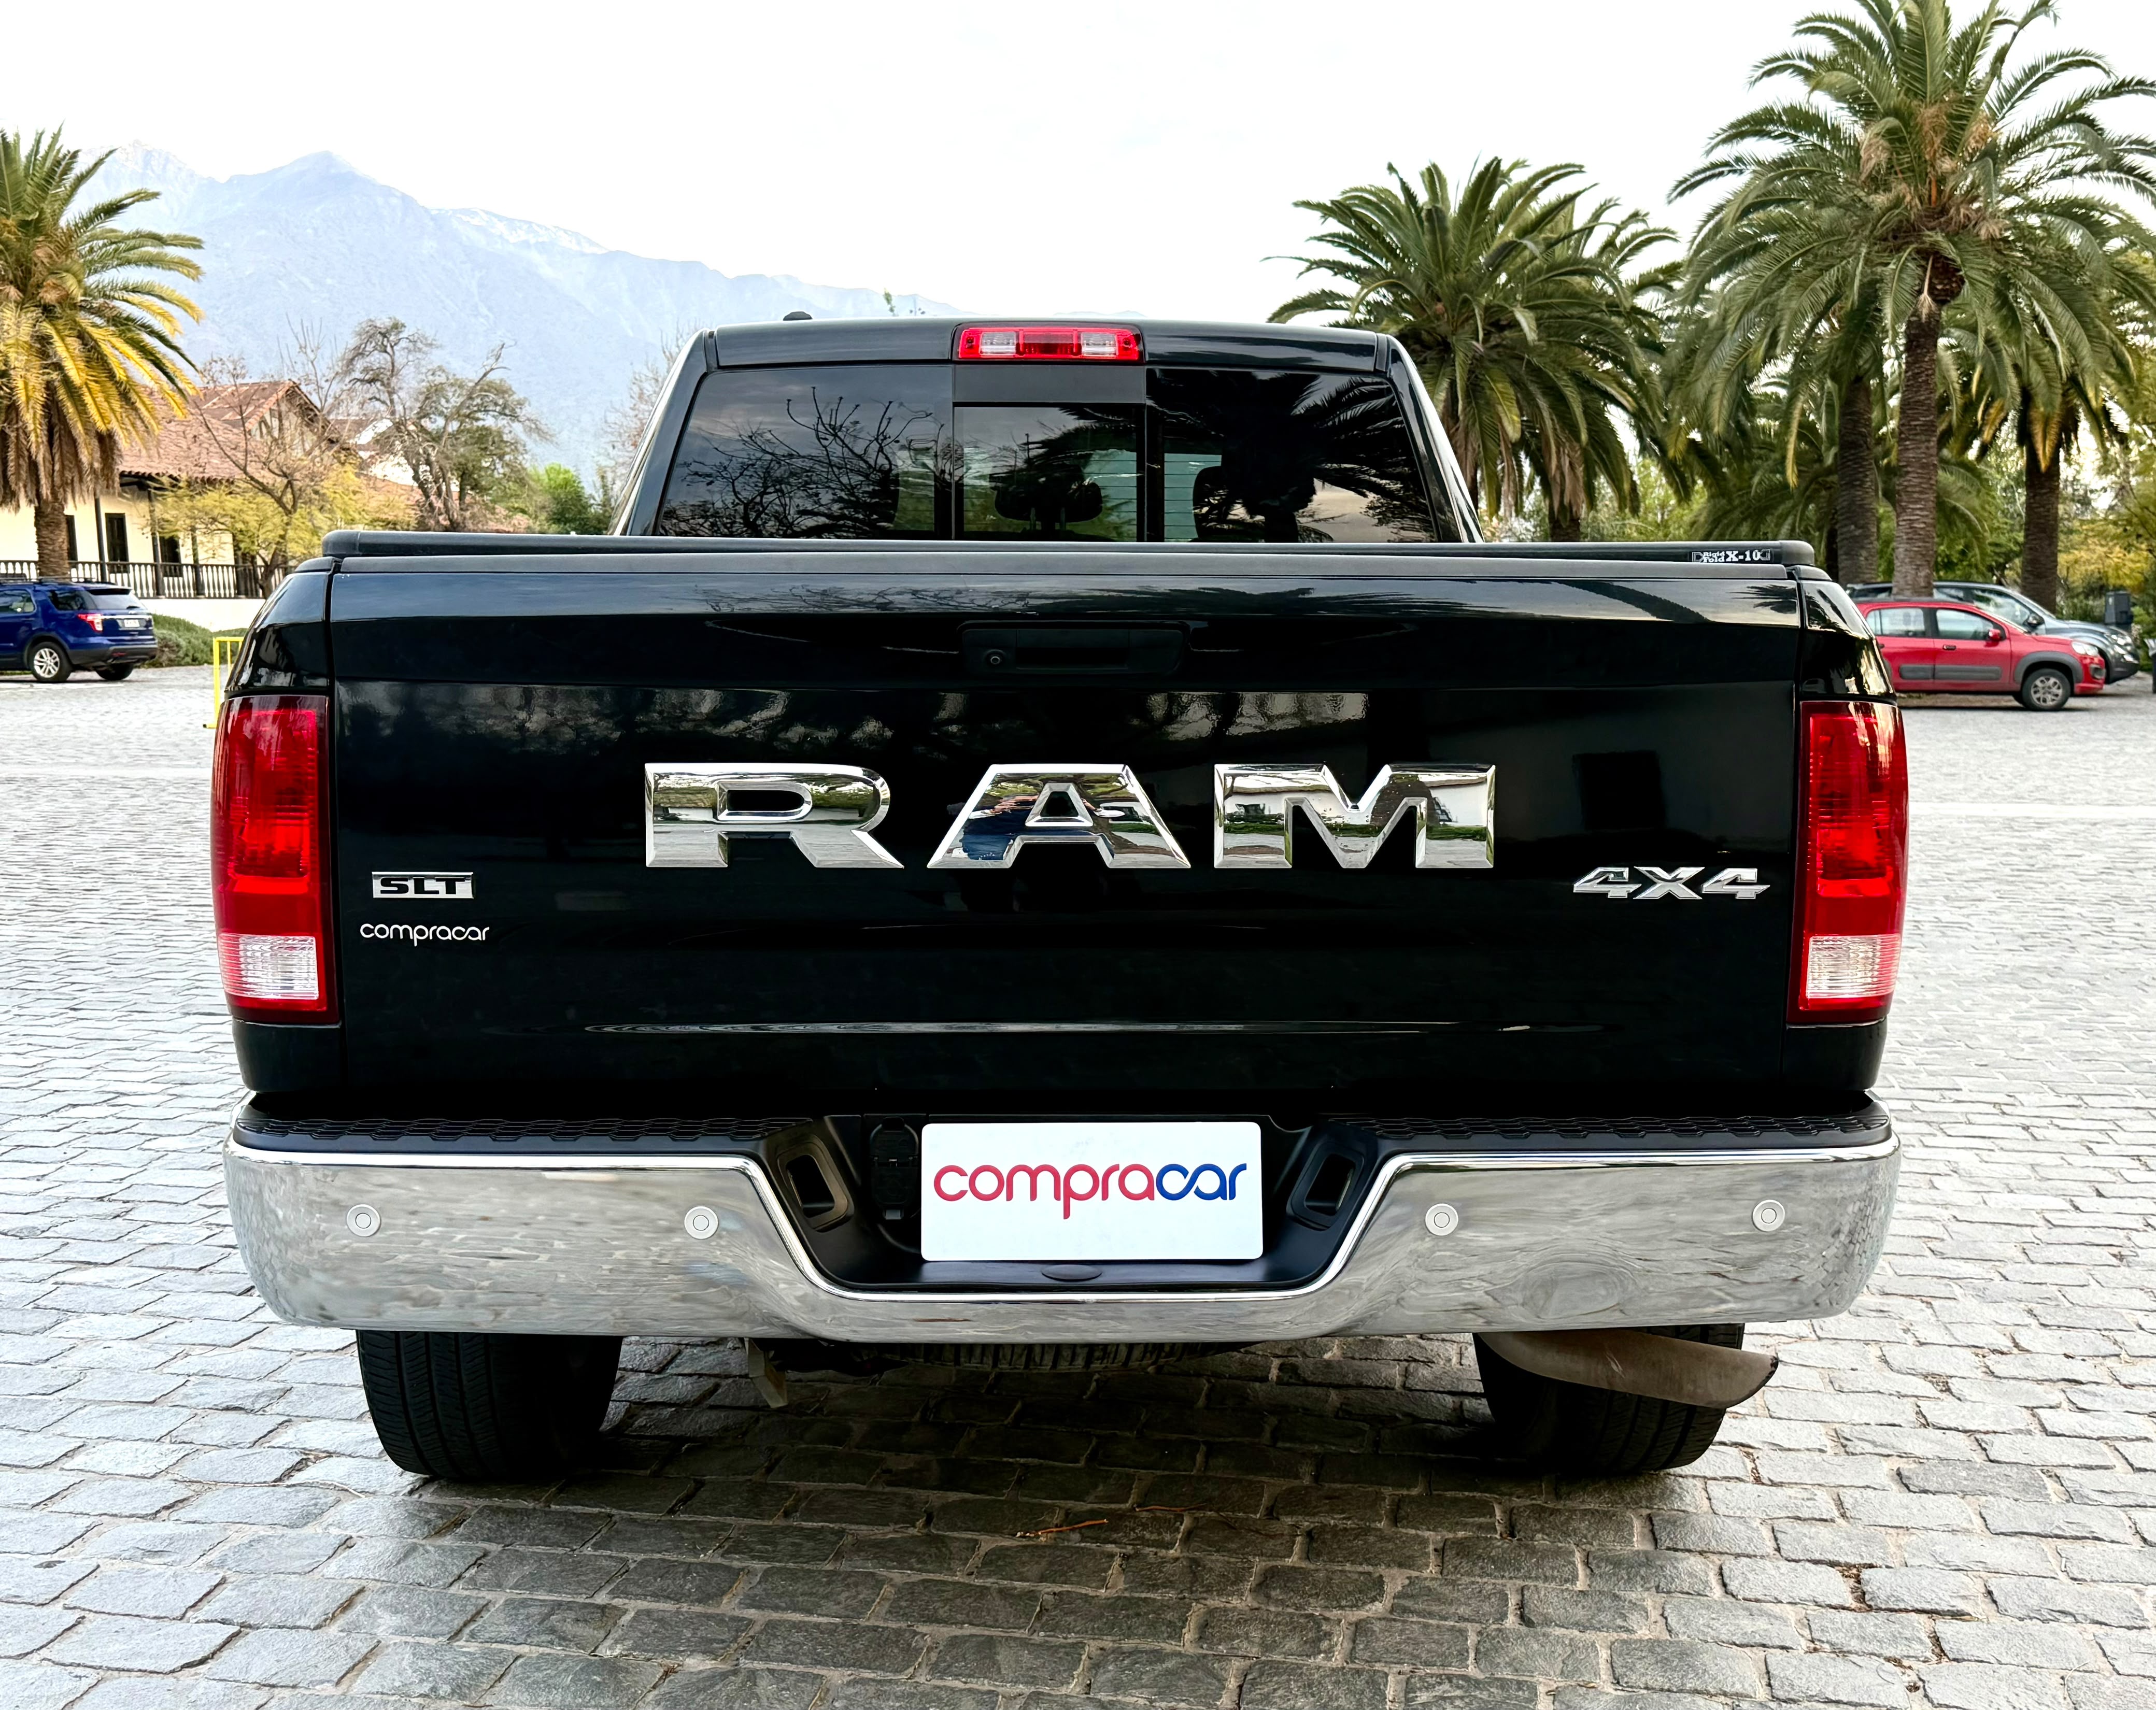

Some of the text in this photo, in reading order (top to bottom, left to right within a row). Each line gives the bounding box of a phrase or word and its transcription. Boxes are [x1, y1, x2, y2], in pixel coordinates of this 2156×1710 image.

[644, 763, 1496, 868] RAM
[379, 876, 466, 895] SLT
[1573, 866, 1770, 900] 4X4
[360, 923, 490, 947] compracar
[933, 1163, 1247, 1220] compracar
